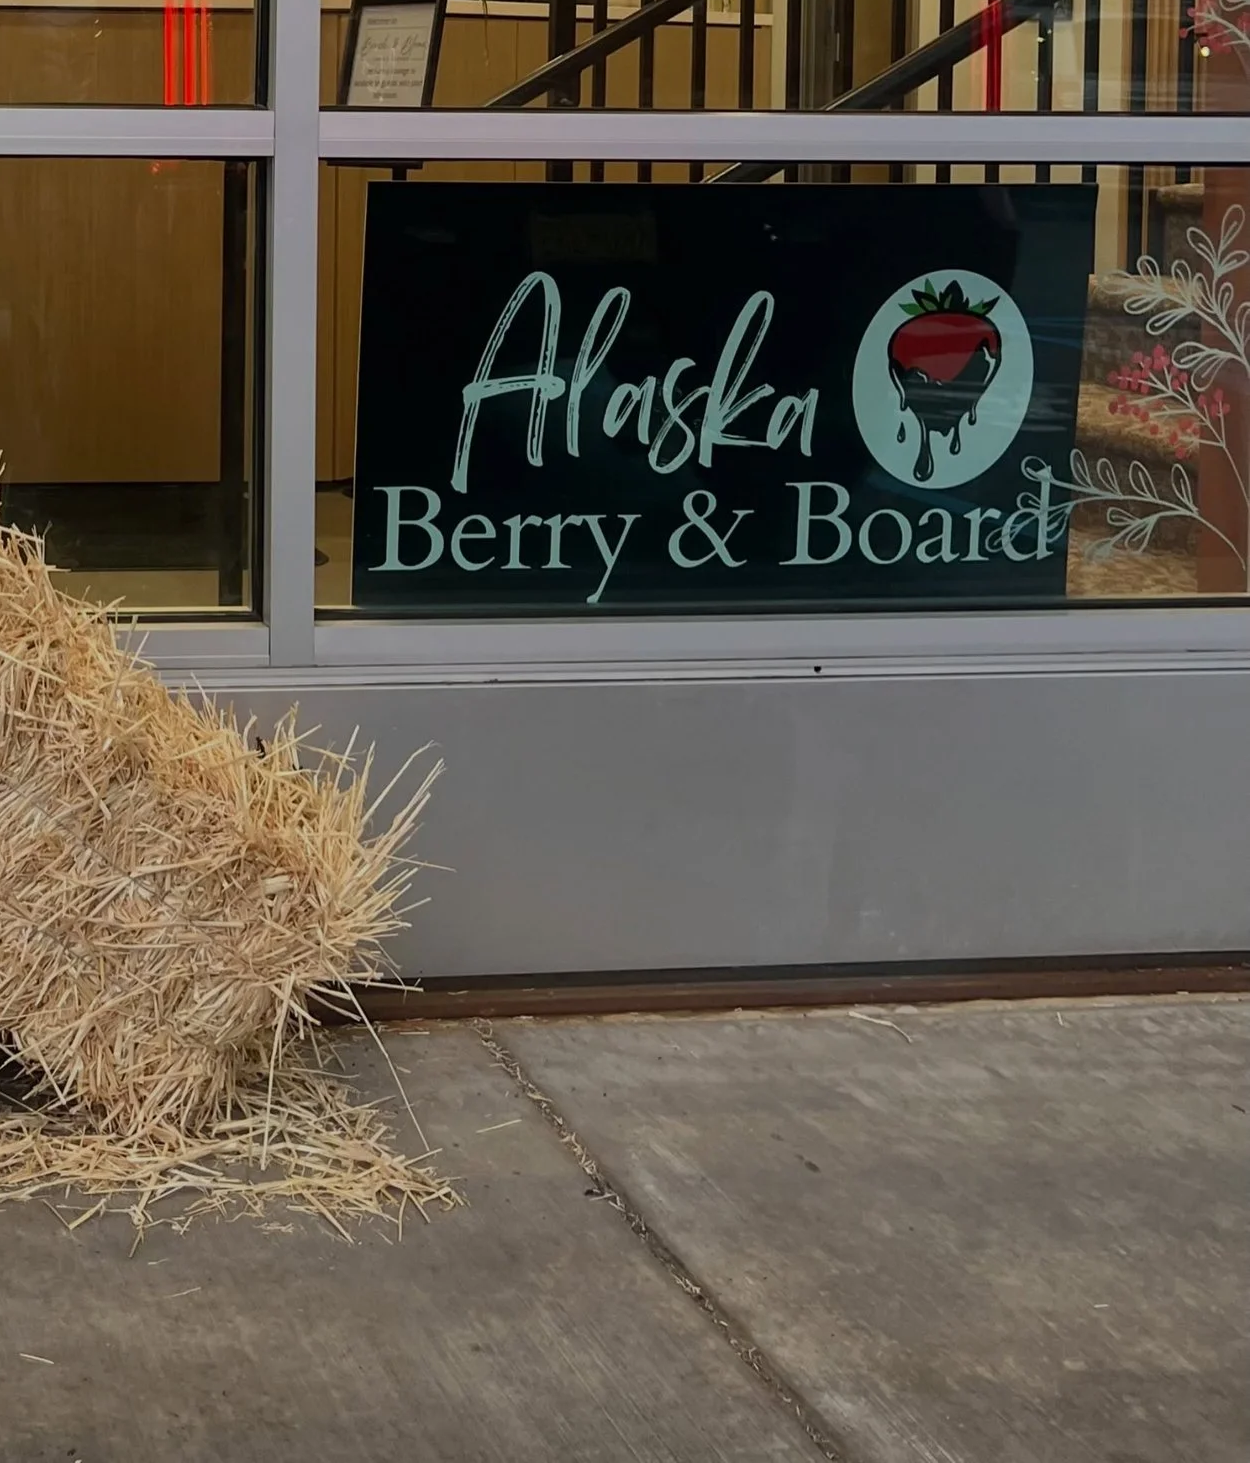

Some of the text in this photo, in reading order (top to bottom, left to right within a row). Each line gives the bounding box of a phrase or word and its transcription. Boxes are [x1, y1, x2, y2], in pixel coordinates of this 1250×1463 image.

[452, 271, 819, 494] Alaska
[367, 465, 1055, 604] Berry & Board
